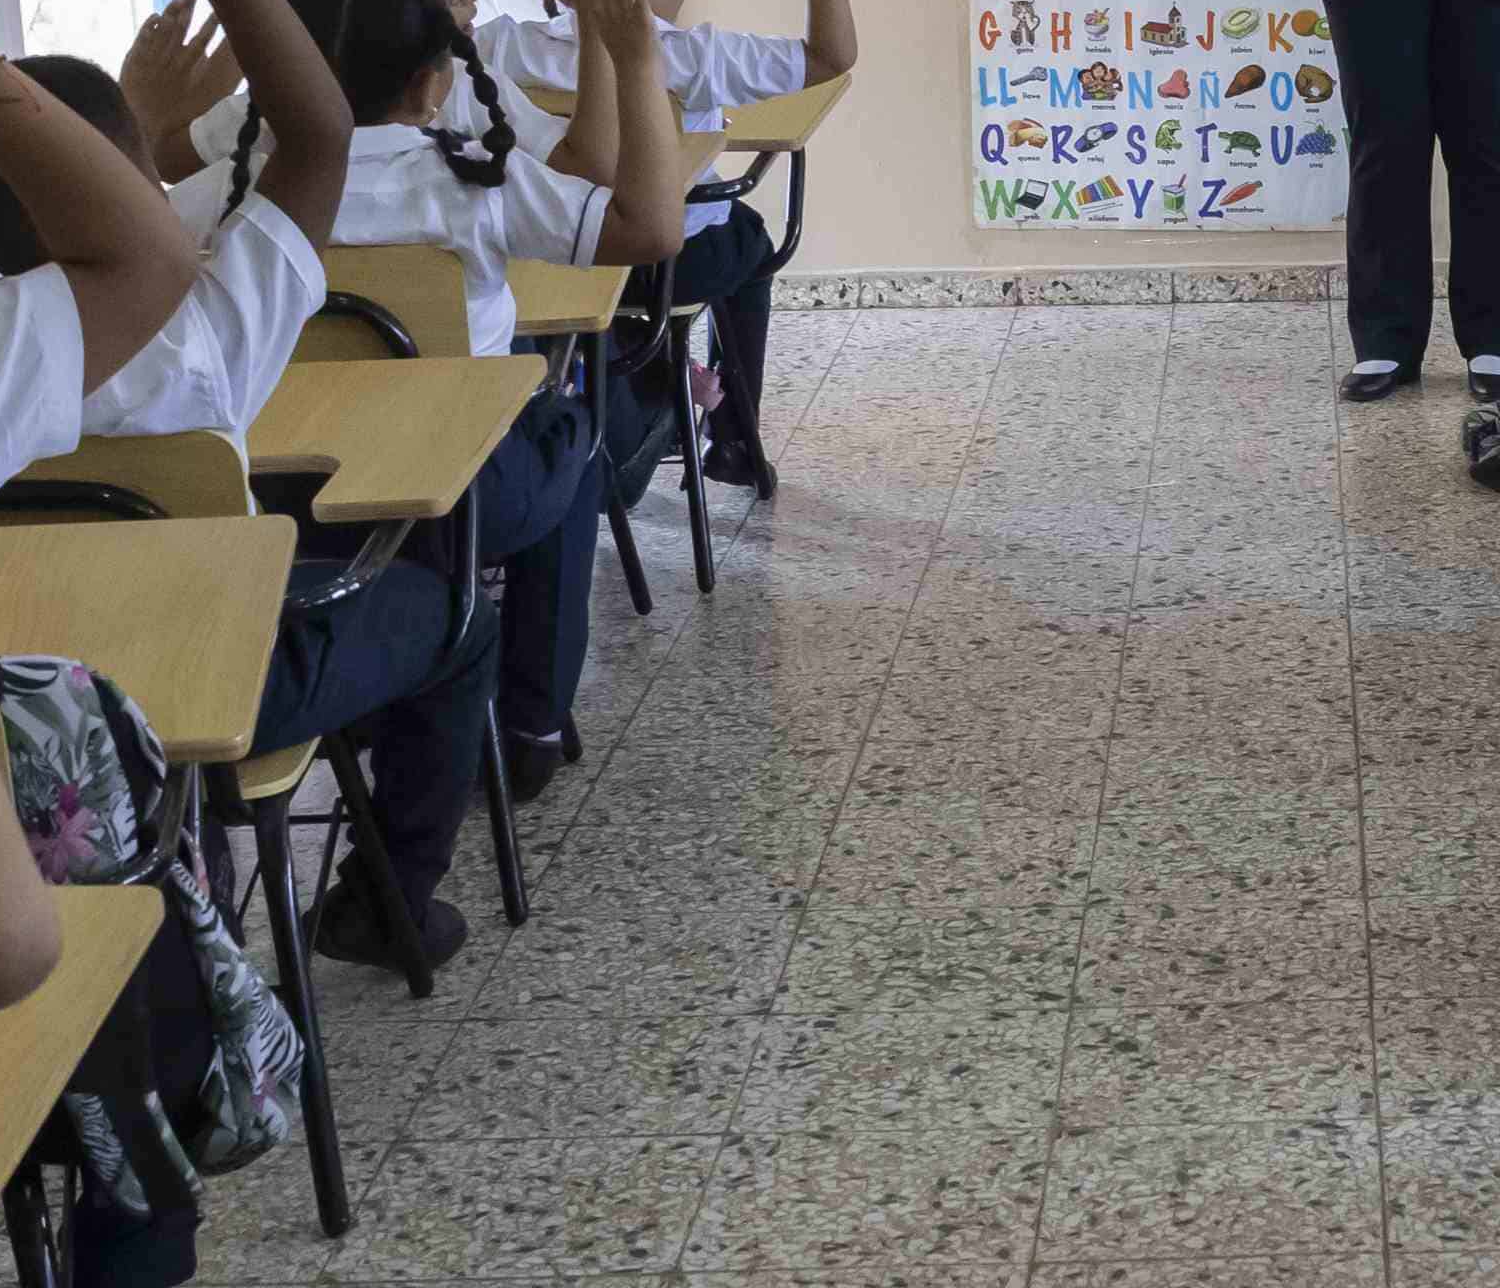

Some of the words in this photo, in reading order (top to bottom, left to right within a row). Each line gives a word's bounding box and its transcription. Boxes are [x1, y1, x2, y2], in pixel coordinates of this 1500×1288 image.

[979, 11, 1002, 50] G
[1051, 12, 1072, 53] H
[1125, 11, 1133, 51] I
[1196, 11, 1215, 51] J
[1268, 13, 1293, 53] K
[978, 67, 1017, 107] LL
[1050, 67, 1082, 108] M
[1128, 70, 1154, 110] N
[1200, 71, 1220, 108] Ñ
[1270, 71, 1293, 111] O
[981, 124, 1008, 165] Q
[1051, 124, 1078, 164] R
[1125, 124, 1147, 165] S
[1195, 123, 1218, 163] T
[1271, 124, 1294, 165] U
[980, 178, 1023, 220] W
[1052, 180, 1079, 220] X
[1127, 179, 1154, 219] Y
[1198, 178, 1227, 218] Z
